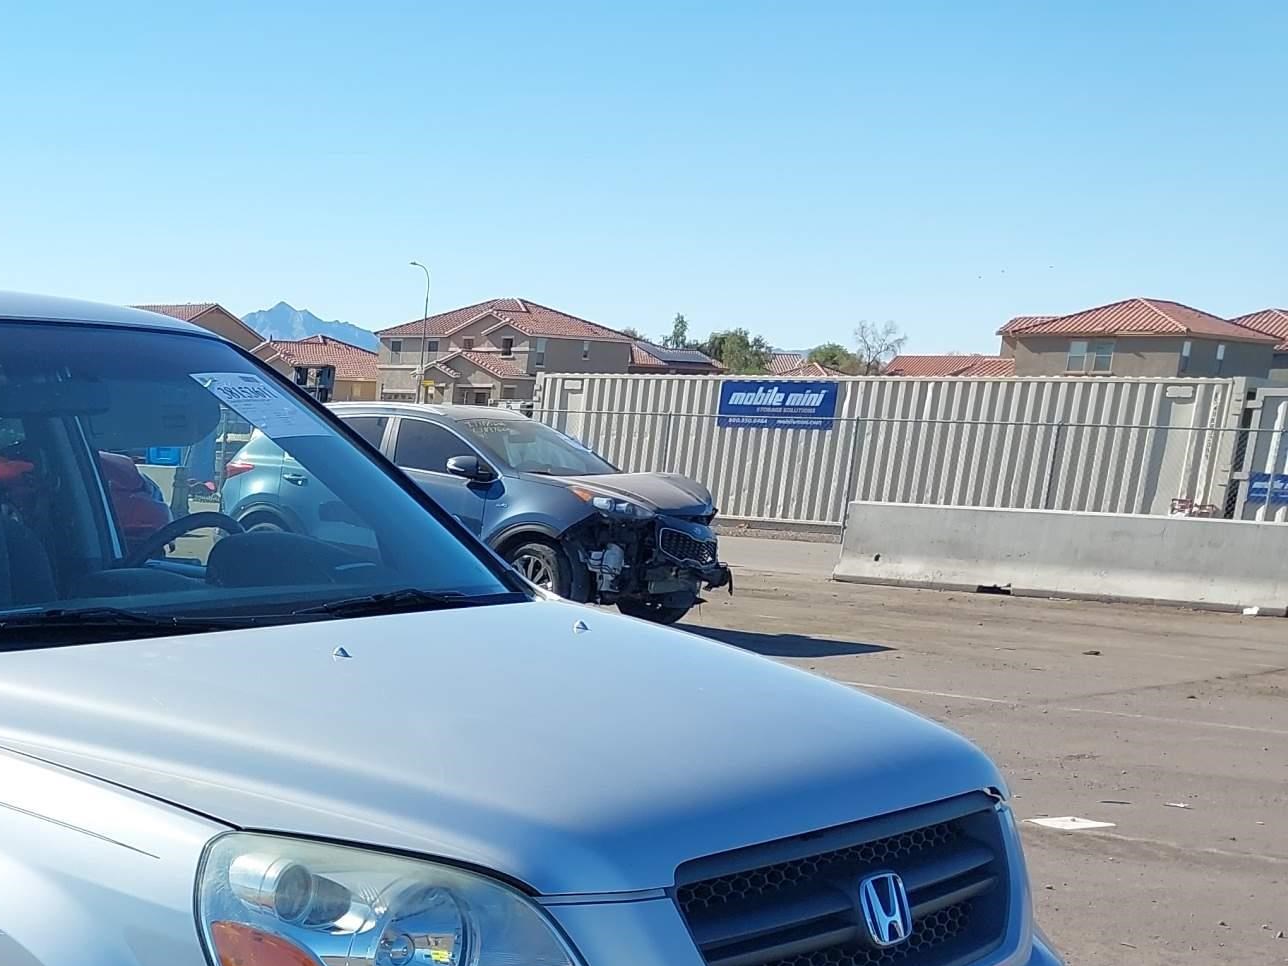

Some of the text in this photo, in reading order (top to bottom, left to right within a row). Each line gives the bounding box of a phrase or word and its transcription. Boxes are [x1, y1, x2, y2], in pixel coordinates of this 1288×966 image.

[217, 386, 278, 399] 38153611
[728, 387, 825, 407] mobile mini
